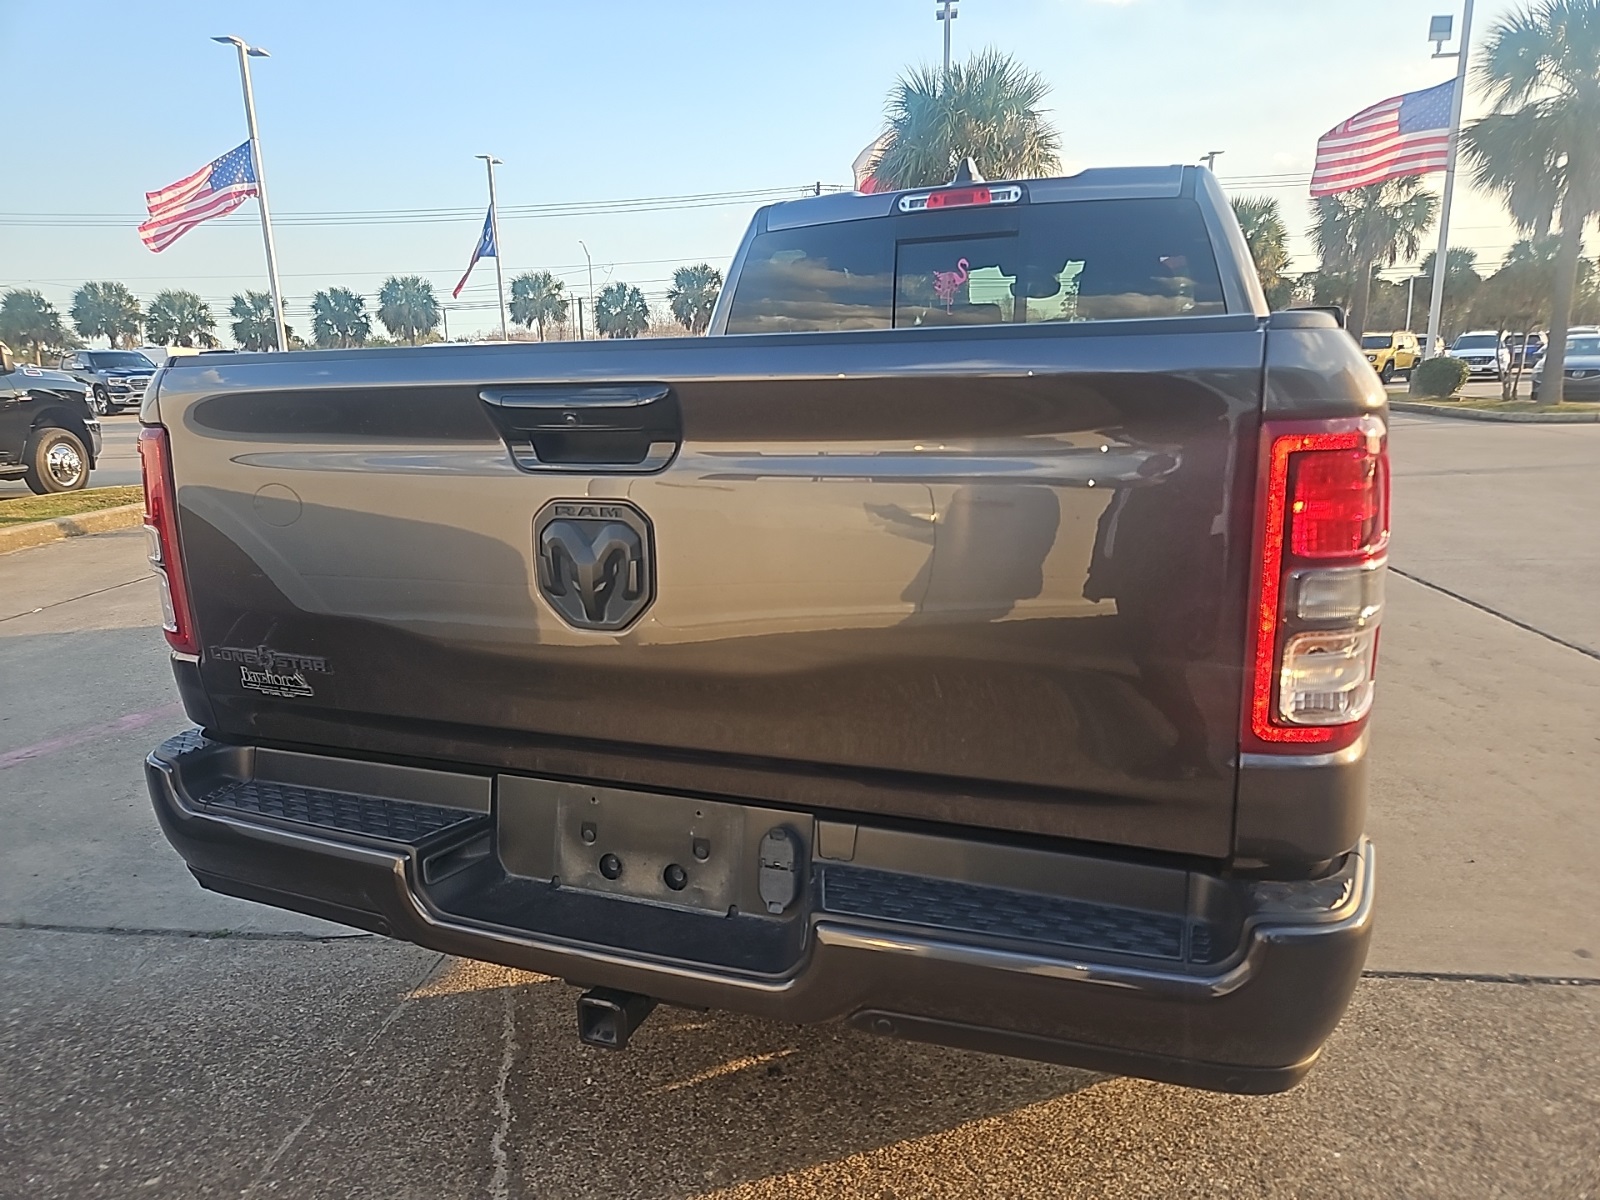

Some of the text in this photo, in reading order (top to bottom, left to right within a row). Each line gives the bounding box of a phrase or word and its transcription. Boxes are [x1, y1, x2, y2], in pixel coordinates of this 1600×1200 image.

[554, 506, 623, 518] RAM
[210, 647, 326, 672] LONE STAR
